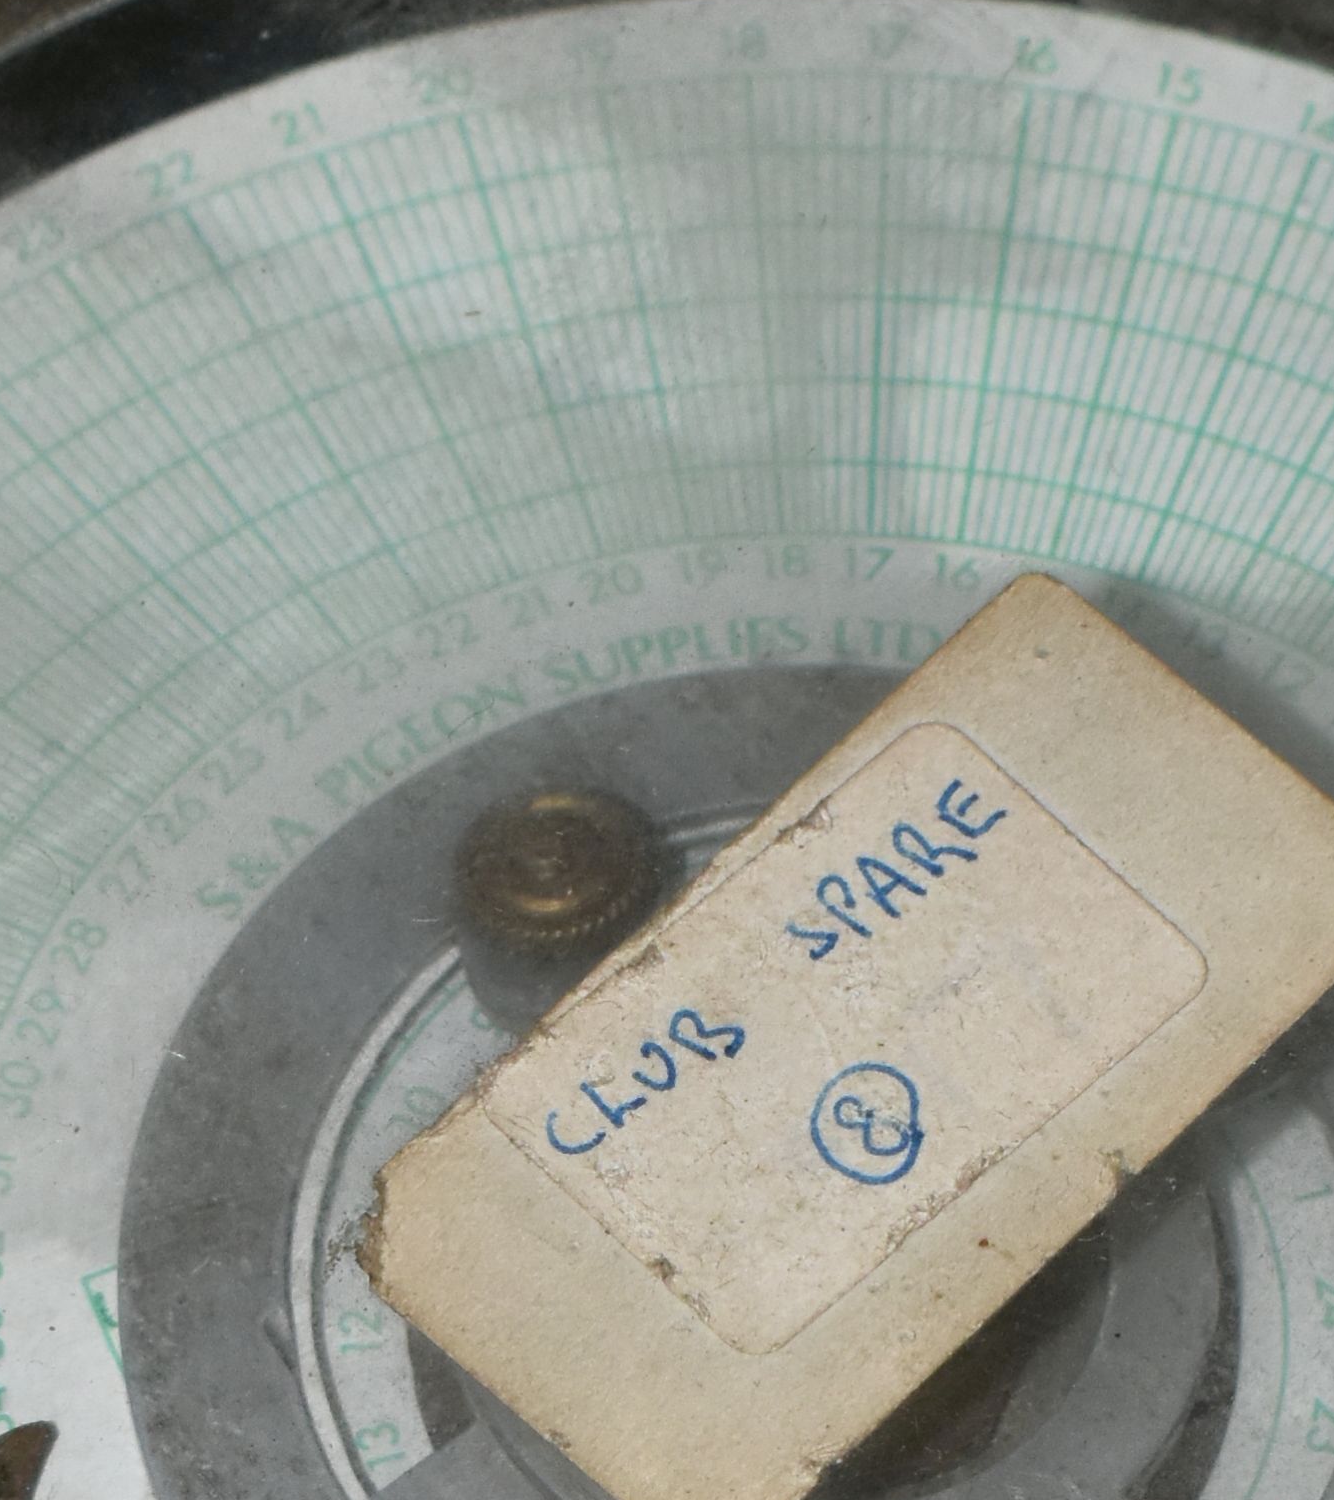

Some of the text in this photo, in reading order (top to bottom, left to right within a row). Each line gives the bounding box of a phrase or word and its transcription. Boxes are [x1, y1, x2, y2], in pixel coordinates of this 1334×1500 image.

[1015, 33, 1059, 76] 16
[1155, 60, 1204, 105] 15
[271, 103, 329, 148] 21
[136, 148, 196, 199] 22
[581, 556, 647, 604] 20
[674, 542, 726, 590] 19
[765, 541, 811, 582] 18
[845, 546, 896, 583] 17
[935, 552, 982, 594] 16
[501, 583, 555, 630] 21
[412, 611, 481, 659] 22
[339, 647, 408, 695] 23
[264, 691, 330, 742] 24
[313, 670, 529, 808] PIGEON
[541, 610, 812, 691] SUPPLIES
[832, 615, 945, 660] LTD
[197, 739, 266, 796] 25
[142, 795, 211, 846] 26
[95, 843, 154, 905] 27
[48, 917, 108, 977] 28
[544, 776, 1010, 1160] CLUB SPARE
[16, 984, 68, 1047] 29
[830, 1088, 917, 1160] 8
[338, 1308, 385, 1355] 12
[354, 1419, 407, 1470] 13
